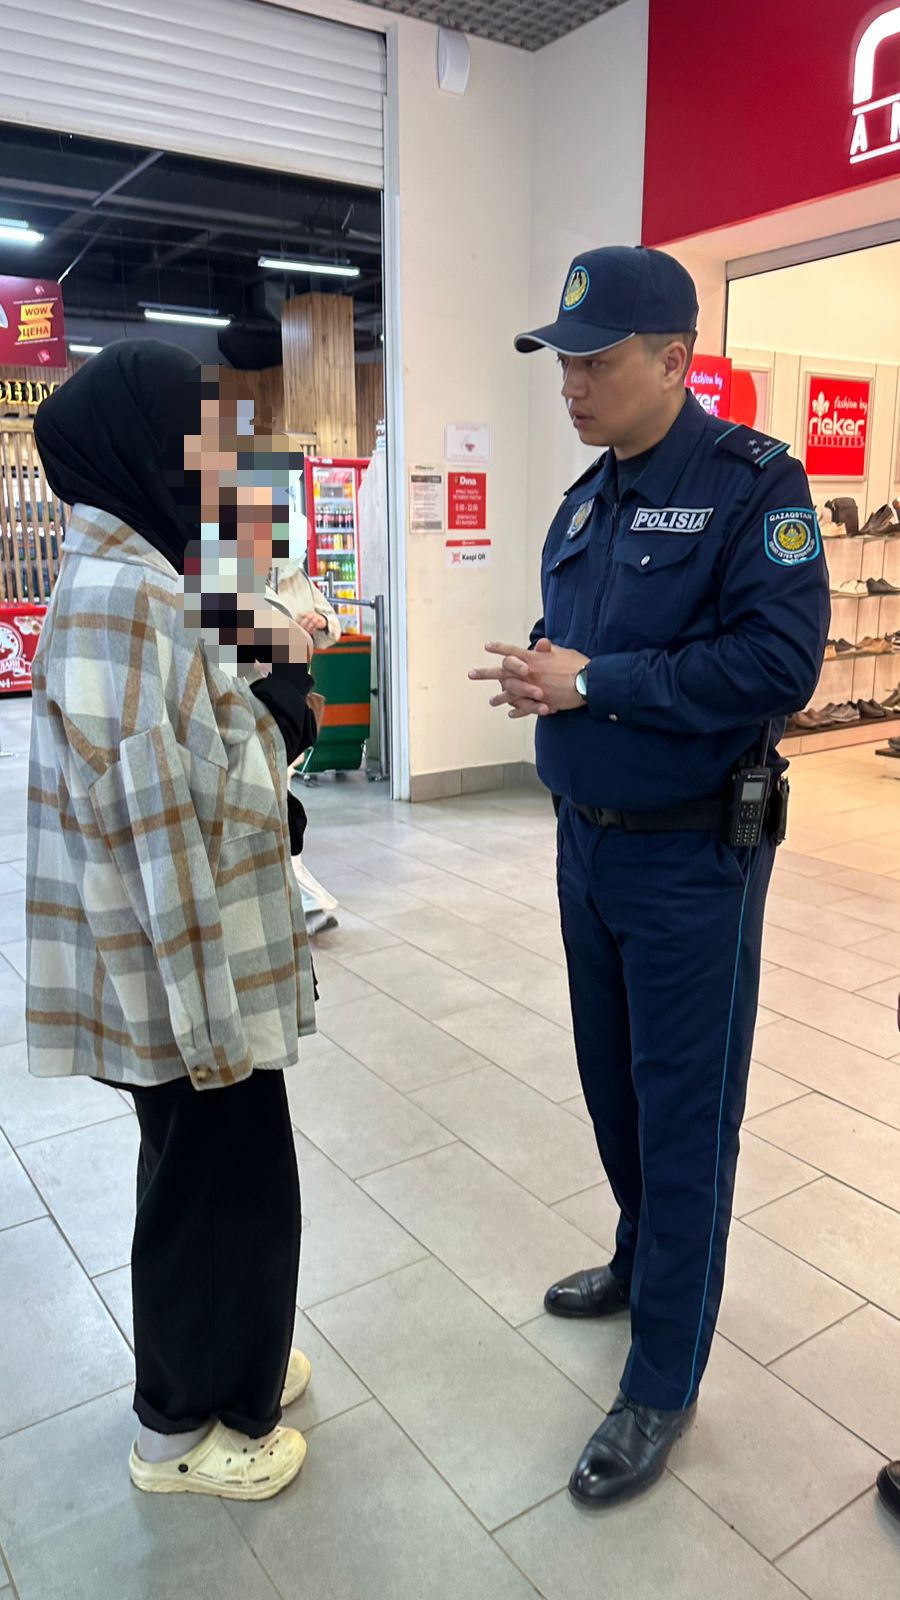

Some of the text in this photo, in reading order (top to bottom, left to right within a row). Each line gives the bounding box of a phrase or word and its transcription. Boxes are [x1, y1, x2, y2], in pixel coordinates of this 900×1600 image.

[25, 306, 49, 316] WOW
[22, 328, 50, 338] ЦЕНА
[691, 371, 723, 390] fashion by
[834, 395, 868, 416] fashion by
[809, 411, 865, 436] rieker
[635, 511, 706, 529] POLISIA
[769, 511, 812, 521] QAZAQSTAN
[462, 553, 486, 562] Kaspi QR
